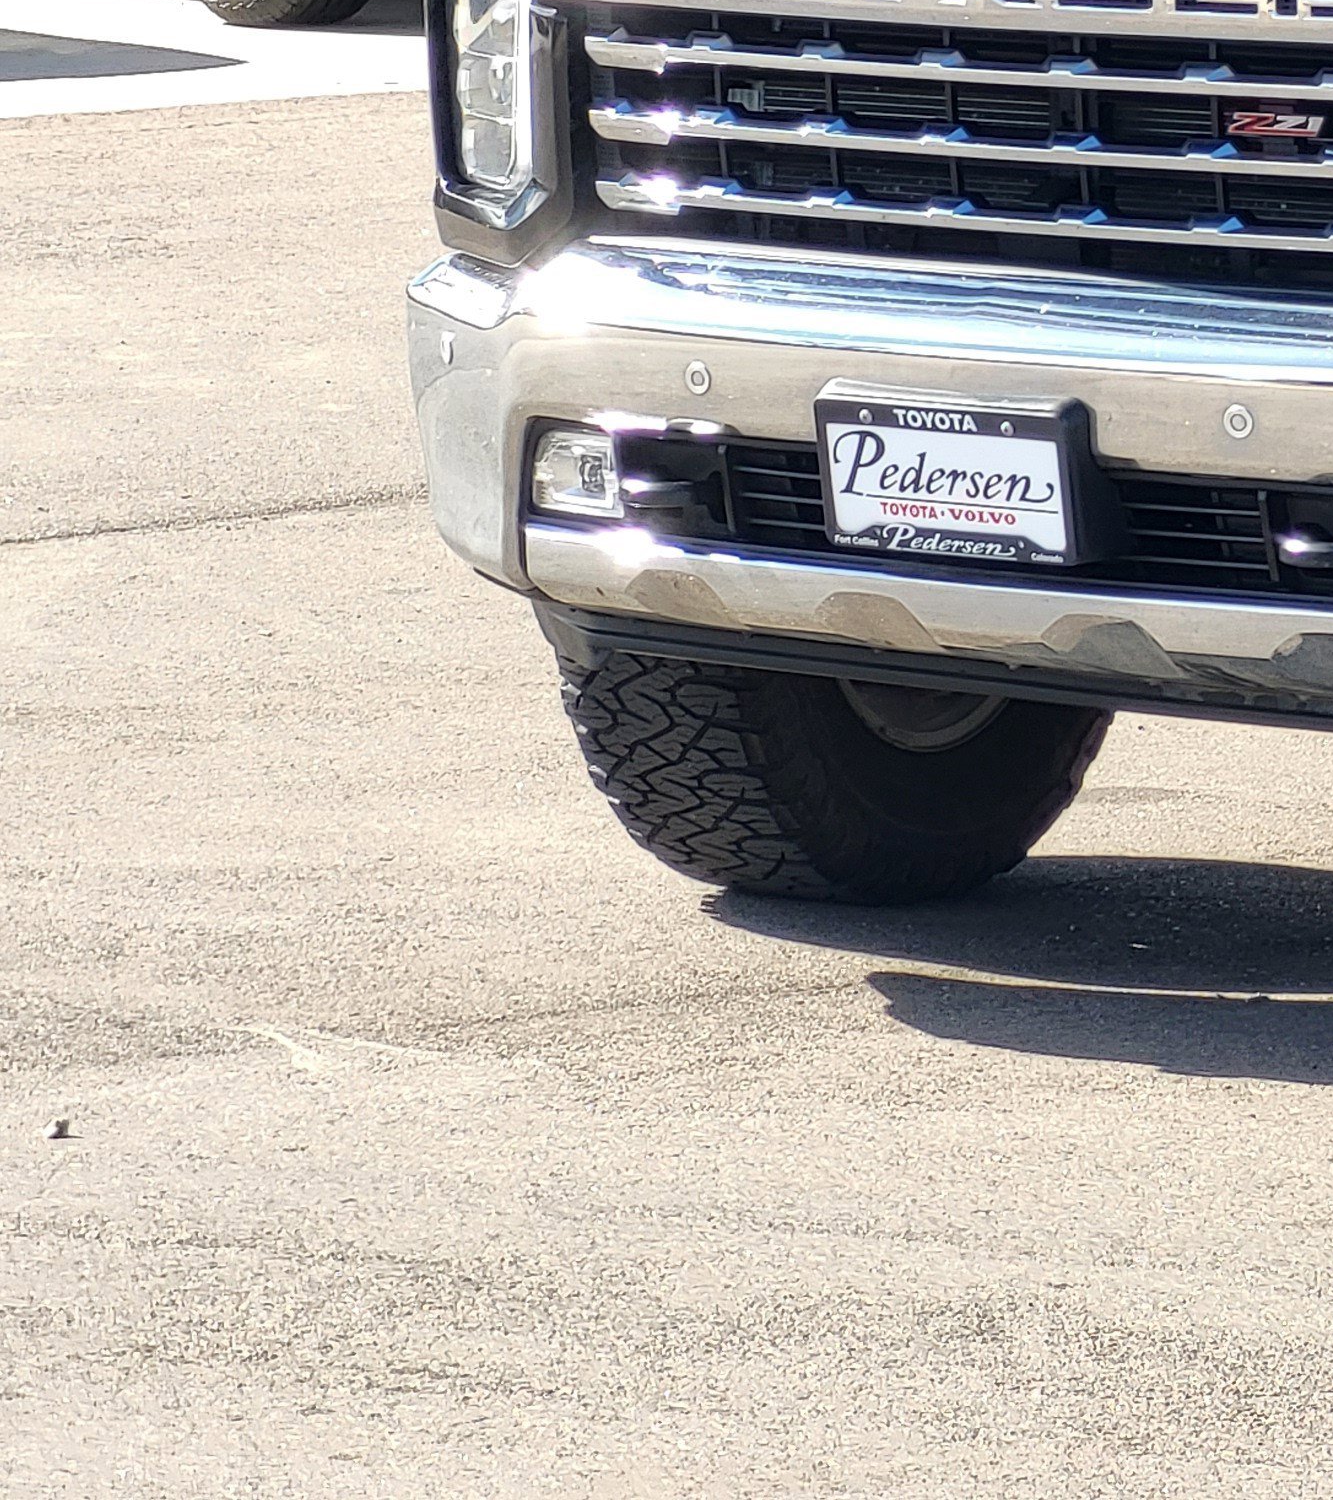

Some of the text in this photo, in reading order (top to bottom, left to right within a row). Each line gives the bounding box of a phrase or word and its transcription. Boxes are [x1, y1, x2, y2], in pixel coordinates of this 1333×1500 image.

[1228, 110, 1324, 138] Z71
[893, 408, 978, 433] TOYOTA
[833, 430, 1055, 504] Pedersen
[880, 501, 1017, 526] TOYOTA VOLVO
[882, 522, 1017, 557] Pedersen
